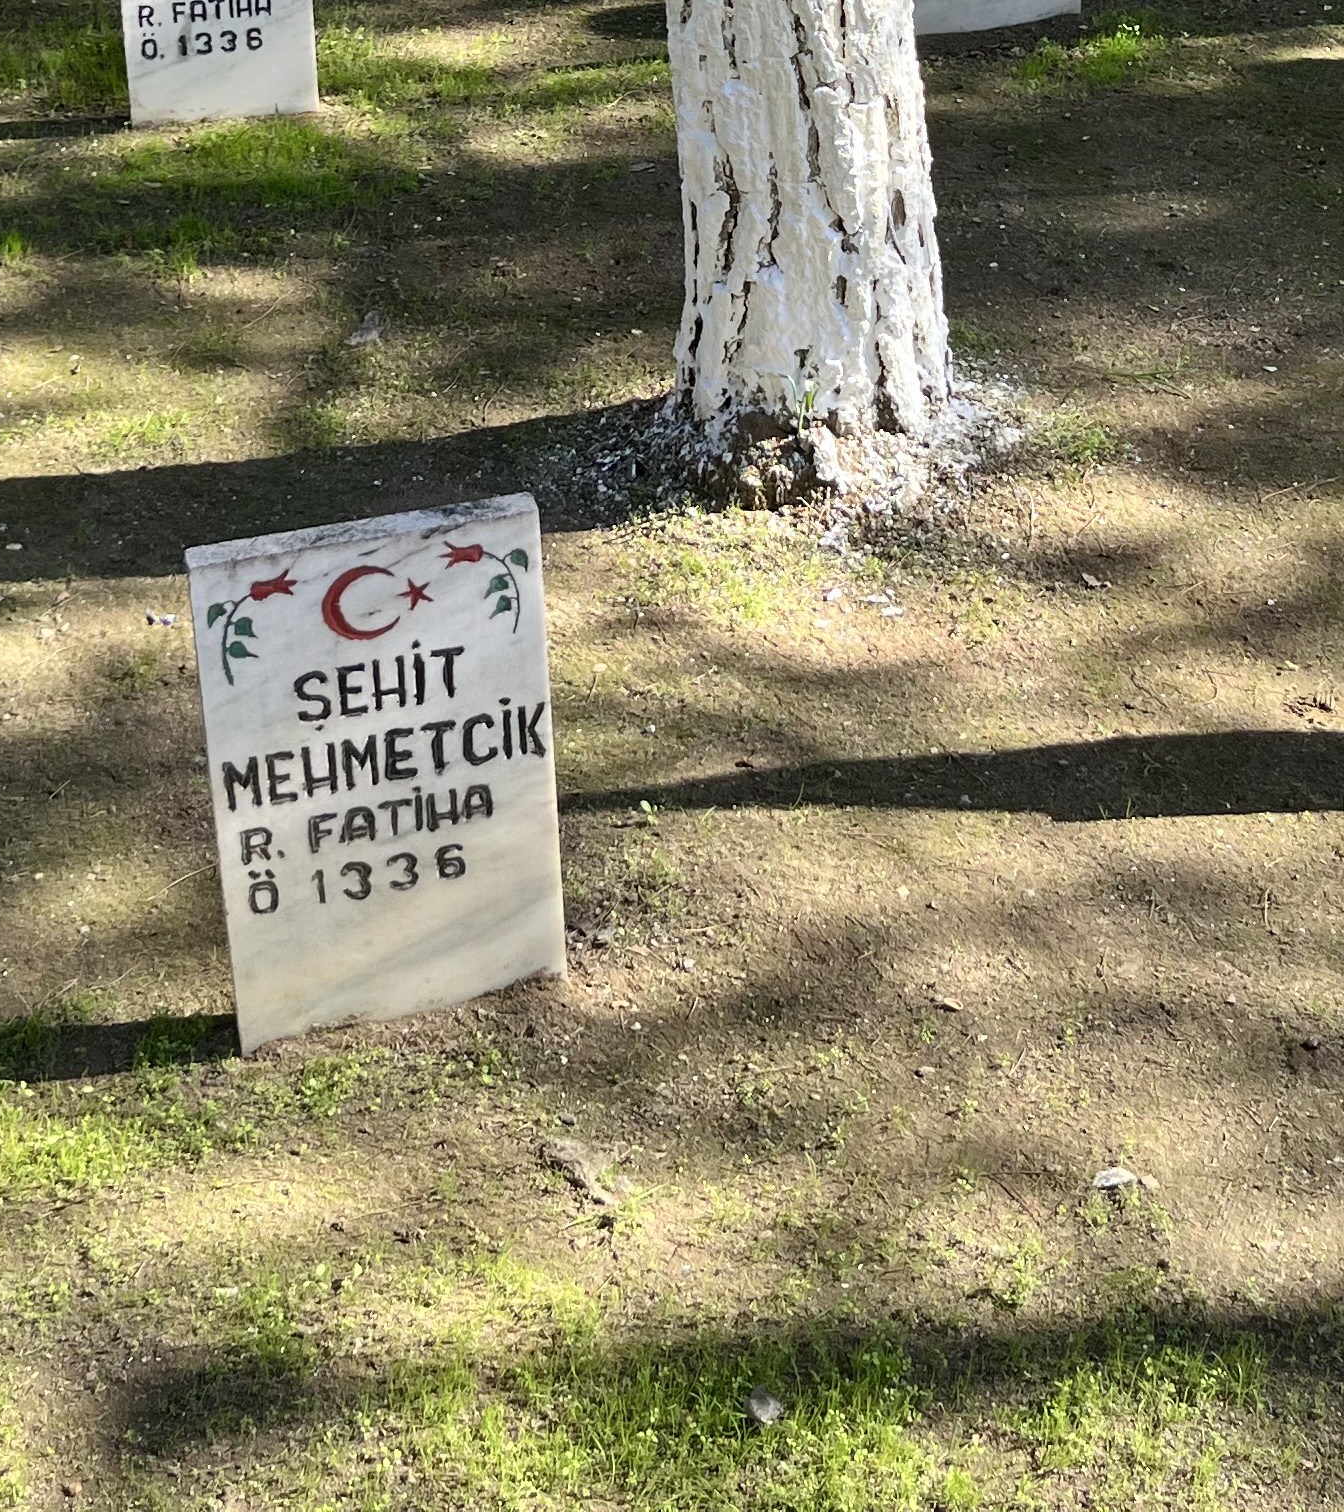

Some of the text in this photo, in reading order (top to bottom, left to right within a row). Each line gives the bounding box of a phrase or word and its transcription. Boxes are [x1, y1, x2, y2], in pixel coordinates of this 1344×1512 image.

[138, 5, 162, 28] R.
[141, 28, 264, 60] Ö. 1336
[294, 639, 465, 731] ŞEHİT
[221, 697, 546, 812] MEHMETCİK
[240, 784, 493, 865] R. FATİHA
[248, 843, 466, 914] Ö 1336
